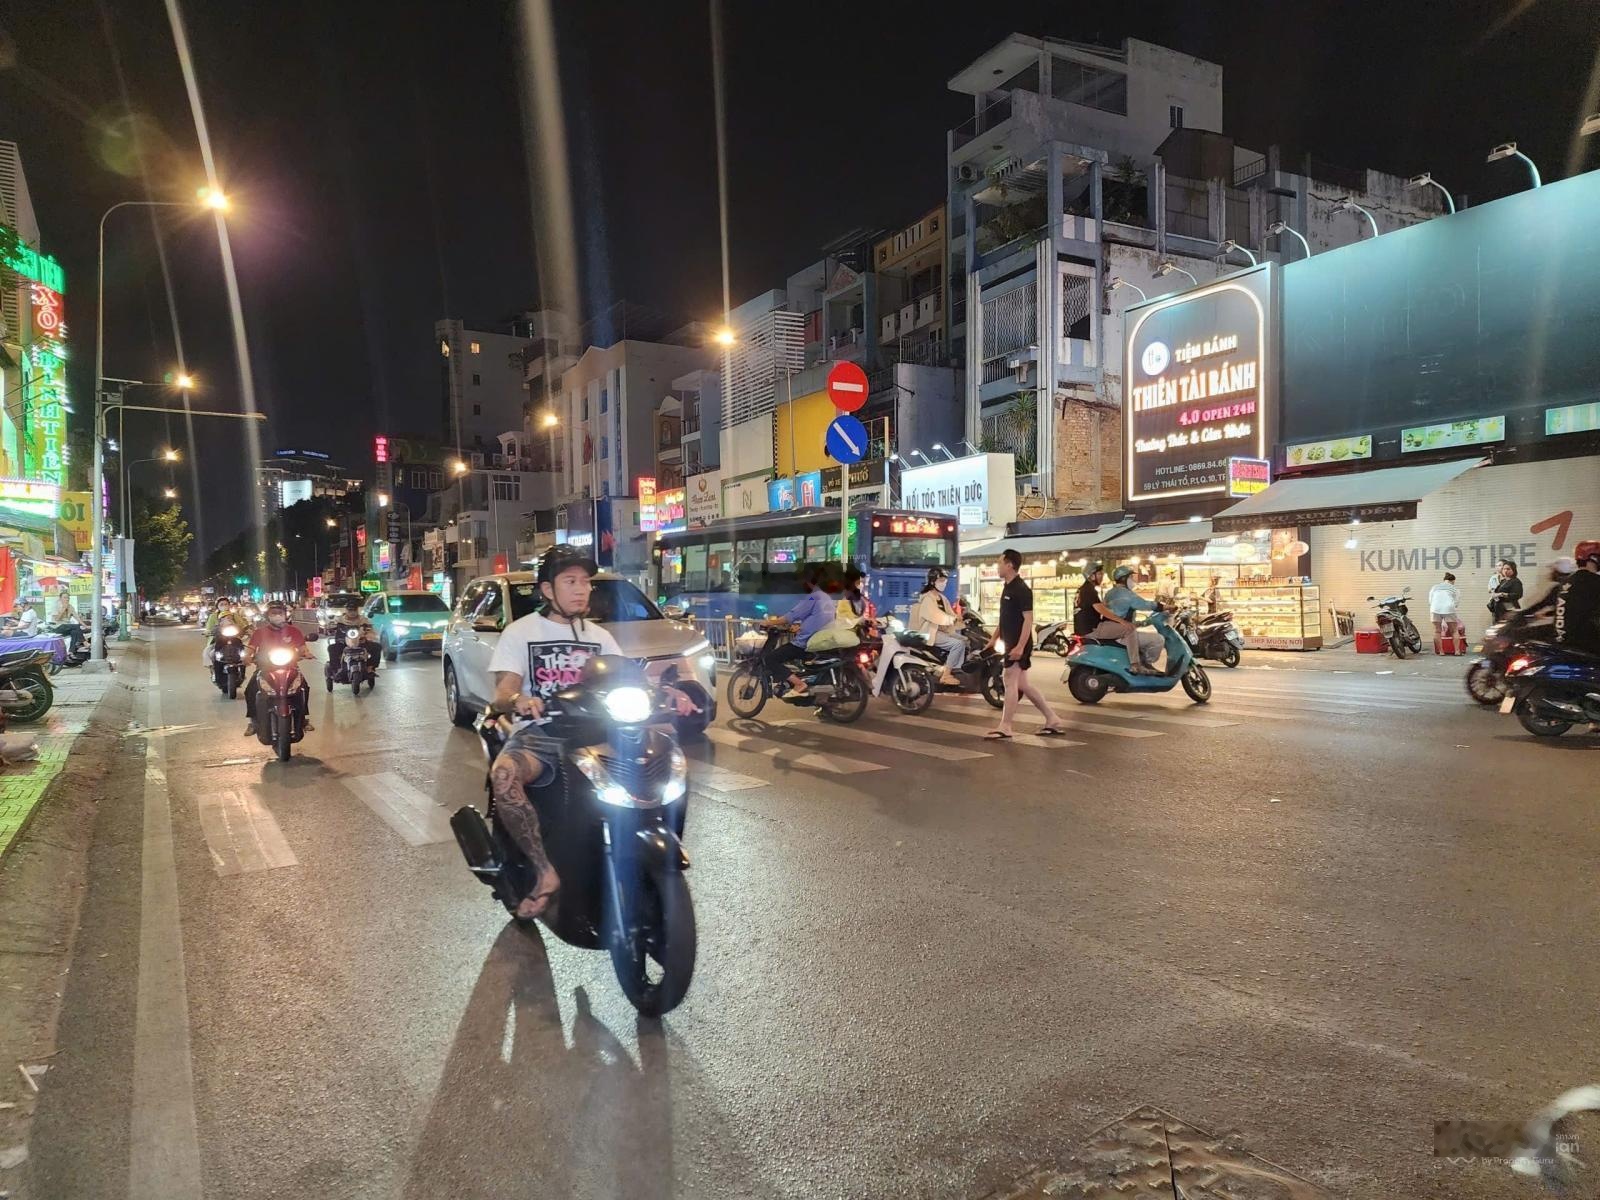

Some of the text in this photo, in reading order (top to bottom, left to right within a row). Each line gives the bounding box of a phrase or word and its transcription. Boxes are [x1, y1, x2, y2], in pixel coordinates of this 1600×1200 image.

[1203, 335, 1238, 356] BÁNH
[1133, 361, 1256, 411] THIÊN TÀI BÁNH
[1179, 401, 1256, 425] 4.0 OPEN 24H
[1190, 428, 1200, 444] &
[1161, 478, 1177, 488] THÁI
[906, 487, 919, 511] NỐI
[921, 487, 936, 509] TÓC
[964, 480, 983, 502] ĐỨC
[58, 498, 85, 522] ÔI
[1295, 507, 1354, 521] XUYÊN
[1359, 504, 1405, 517] ĐÊM
[1359, 542, 1537, 572] KUMHO TIRE
